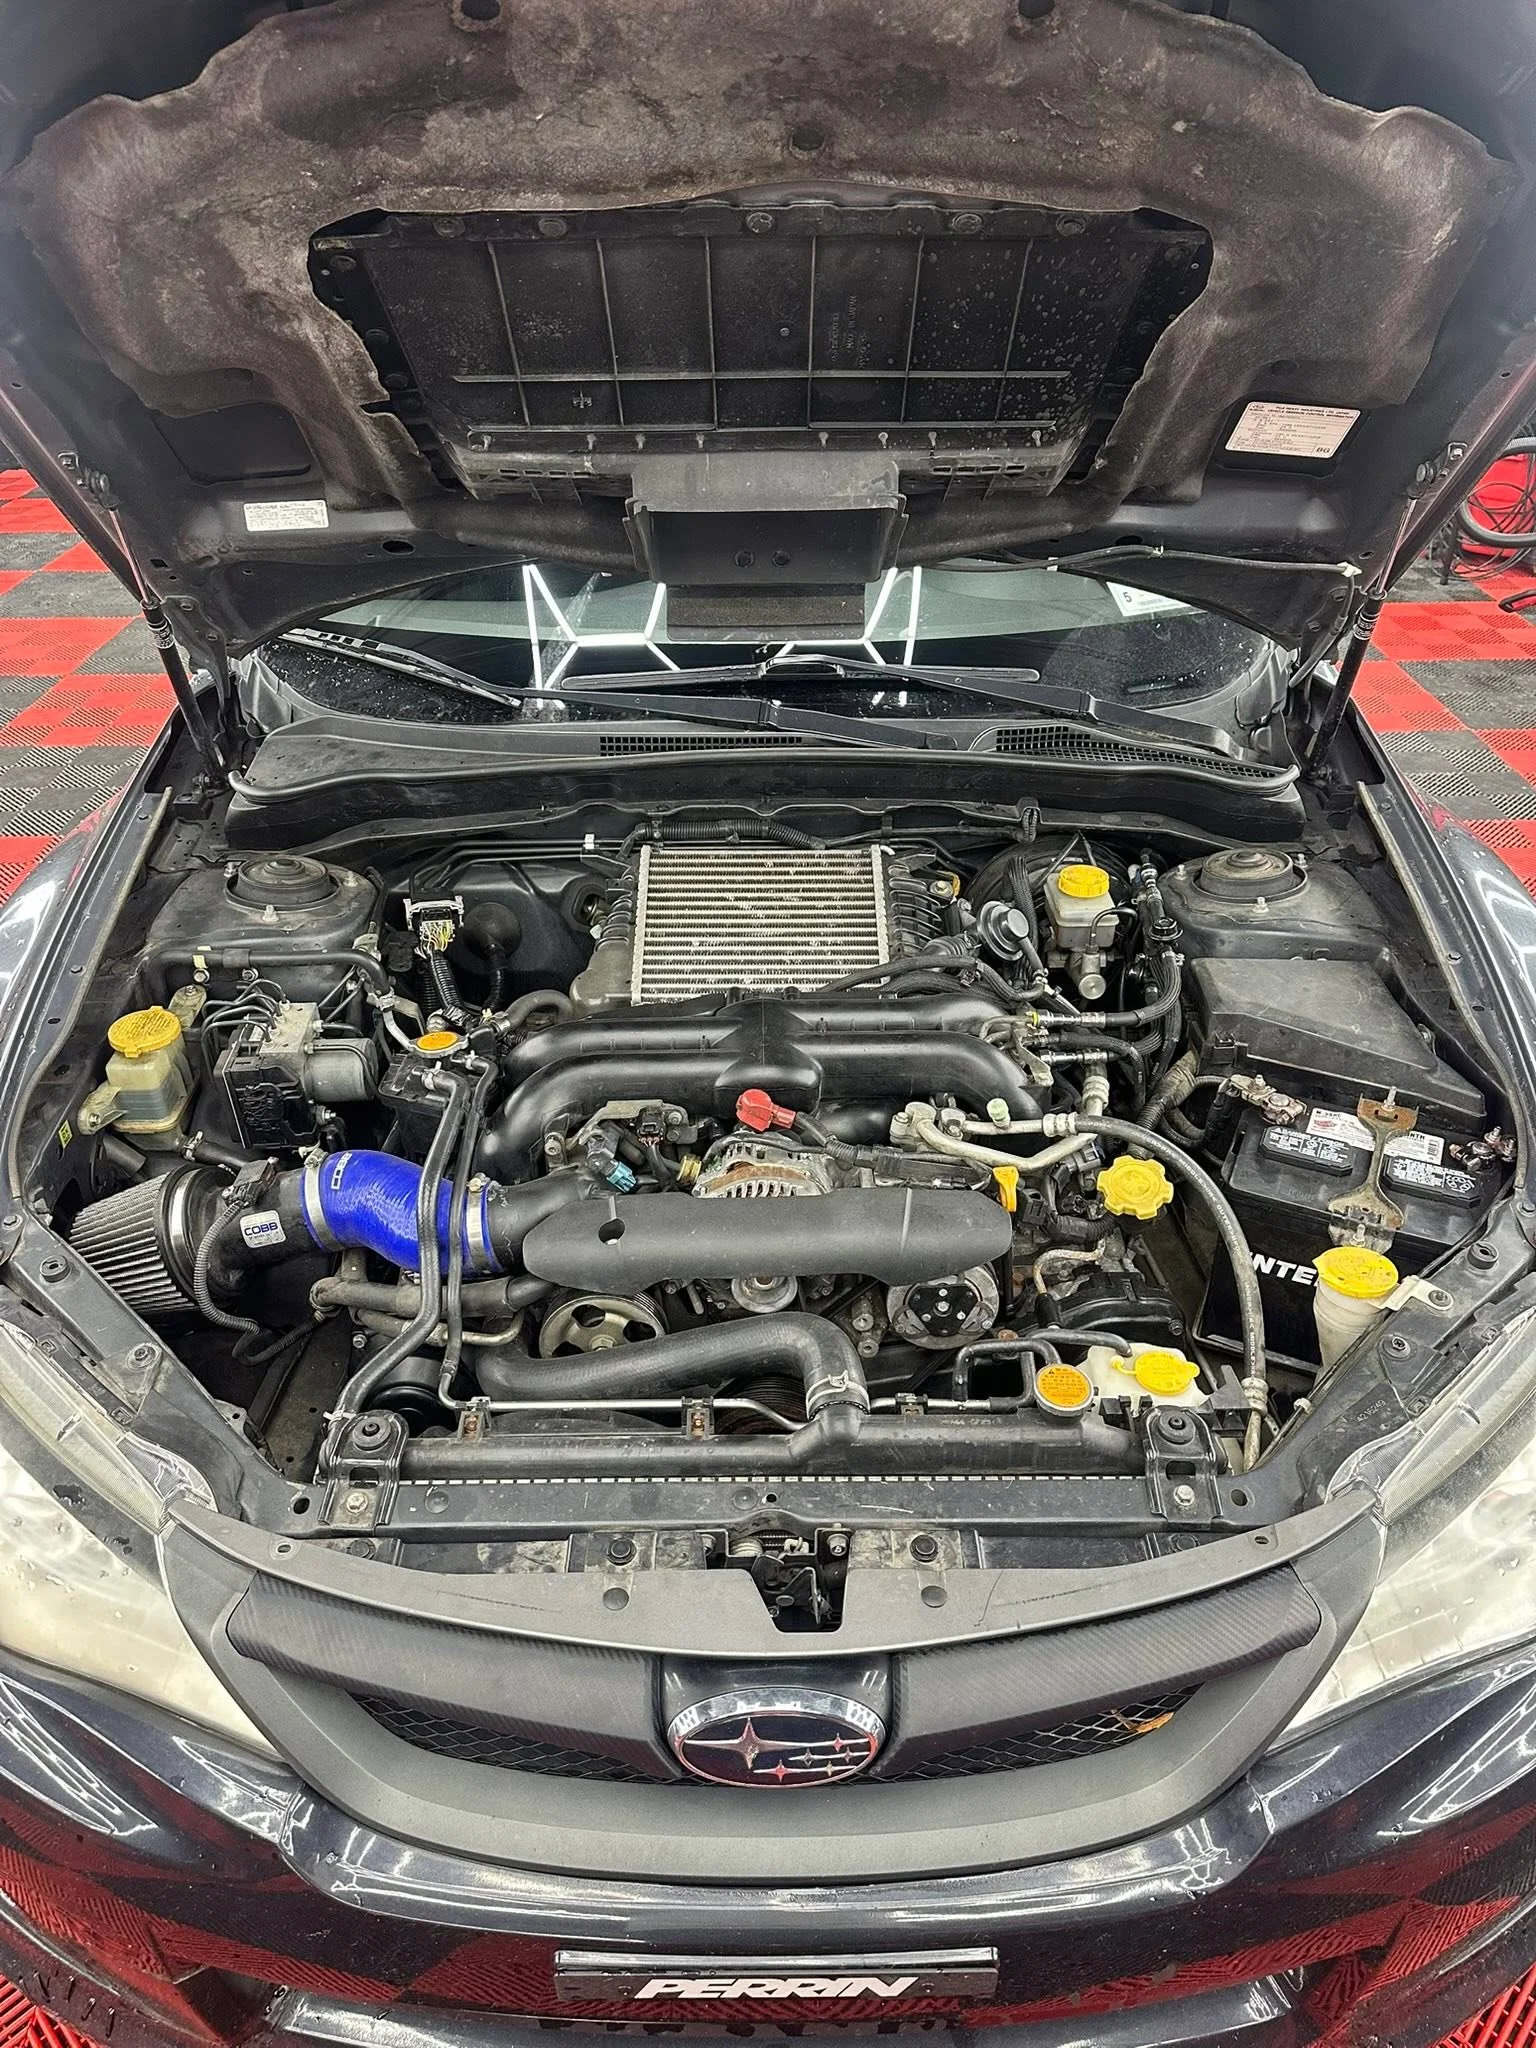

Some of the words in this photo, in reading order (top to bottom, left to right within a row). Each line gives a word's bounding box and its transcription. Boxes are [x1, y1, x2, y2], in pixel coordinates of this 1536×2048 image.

[1122, 591, 1132, 603] 5
[331, 1152, 353, 1190] COBB
[244, 1222, 279, 1236] COBB
[1250, 1252, 1319, 1288] NTE
[634, 1976, 919, 1999] PERRIN
